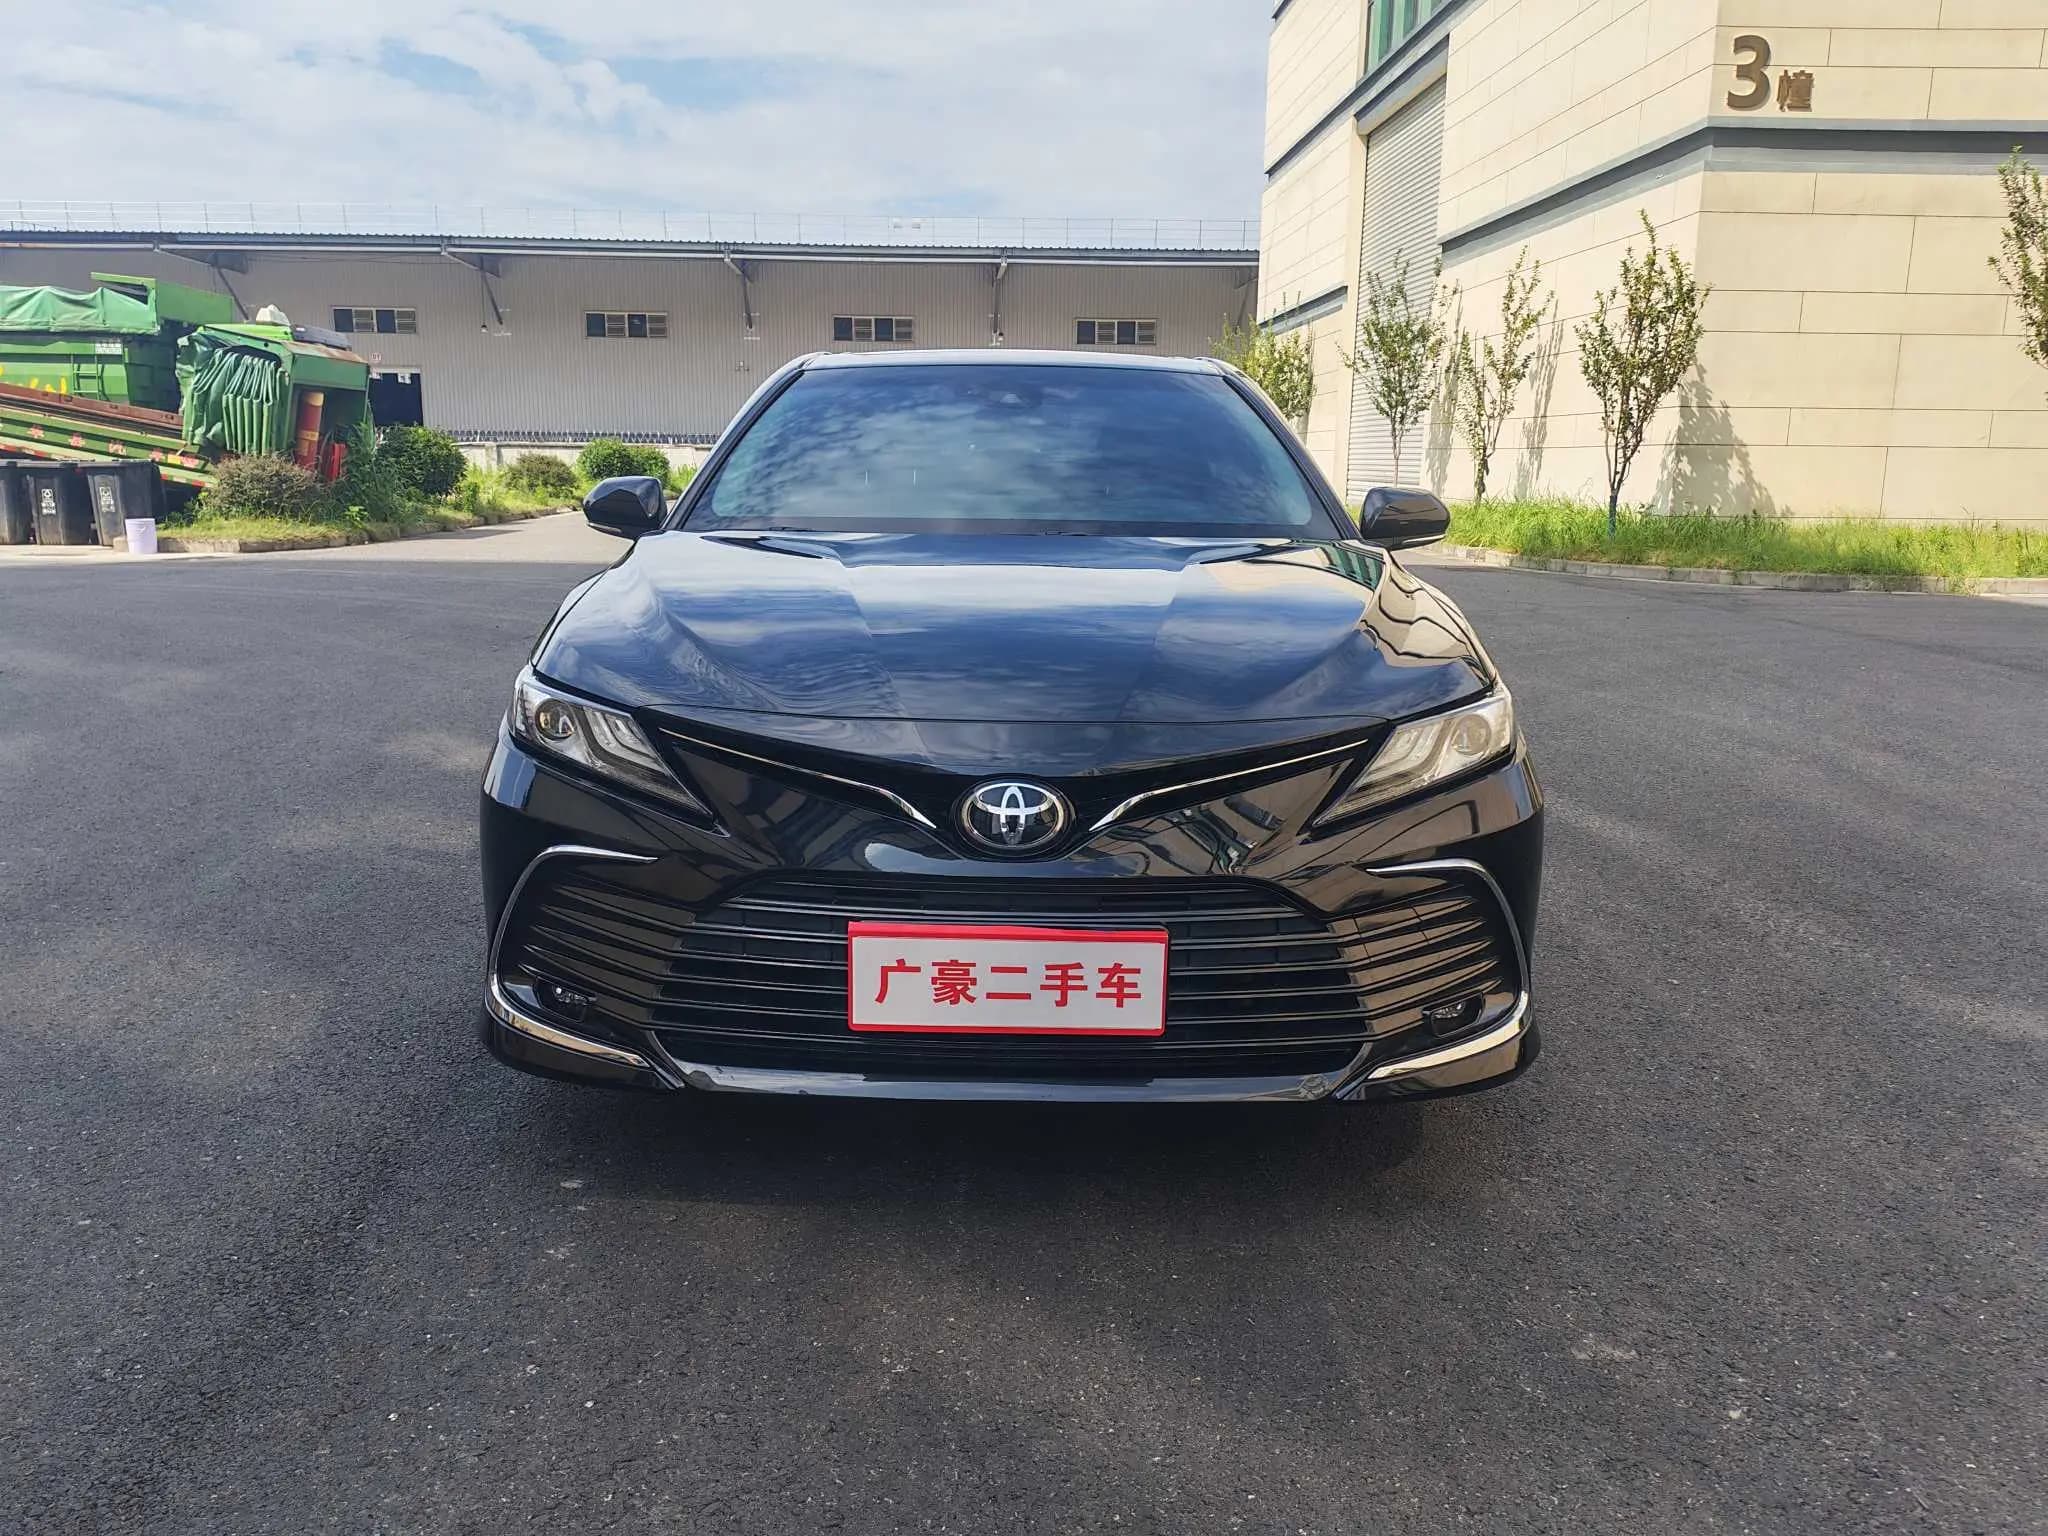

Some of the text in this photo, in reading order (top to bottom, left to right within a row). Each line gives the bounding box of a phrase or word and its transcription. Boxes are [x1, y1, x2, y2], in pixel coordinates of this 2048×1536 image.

[875, 958, 1142, 1008] 广豪二手车
